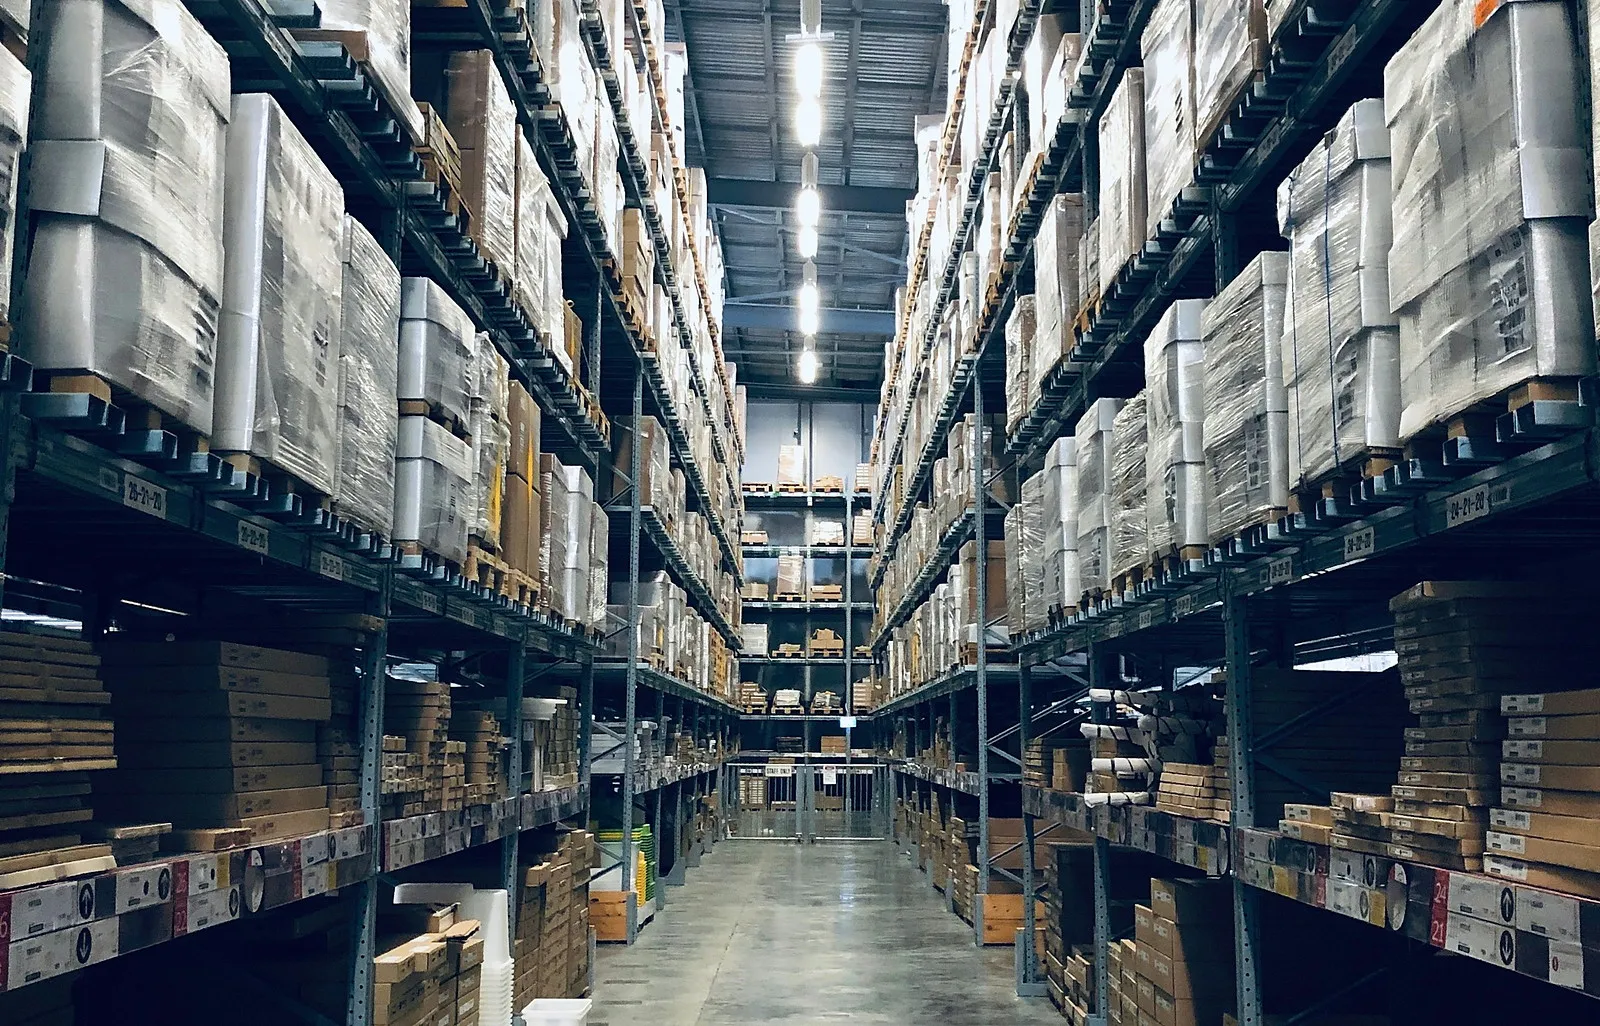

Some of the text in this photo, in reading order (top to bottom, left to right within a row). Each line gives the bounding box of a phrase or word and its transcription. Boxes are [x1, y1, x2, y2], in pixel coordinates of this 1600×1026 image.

[128, 480, 163, 512] 26-21-20
[1450, 491, 1485, 520] 24-21-20
[766, 767, 791, 775] STAFF ONLY
[1434, 881, 1447, 904] 24
[1431, 920, 1444, 943] 21
